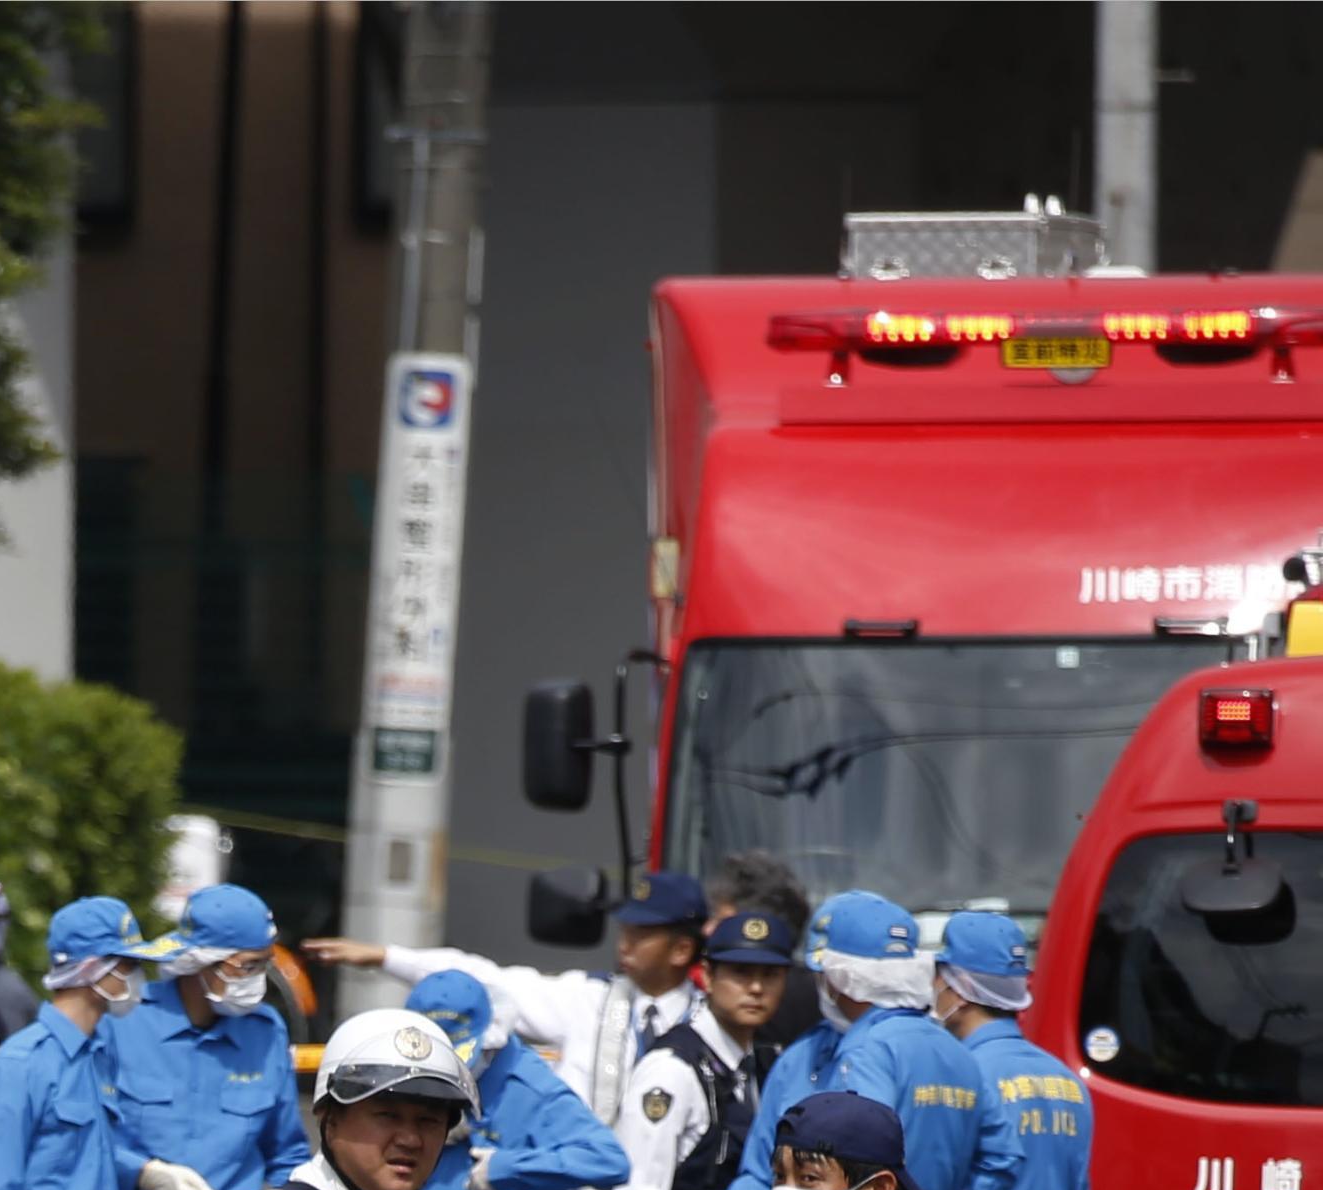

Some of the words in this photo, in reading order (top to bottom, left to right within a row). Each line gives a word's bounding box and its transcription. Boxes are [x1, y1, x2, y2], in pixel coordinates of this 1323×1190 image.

[1079, 565, 1305, 604] 川崎市消防
